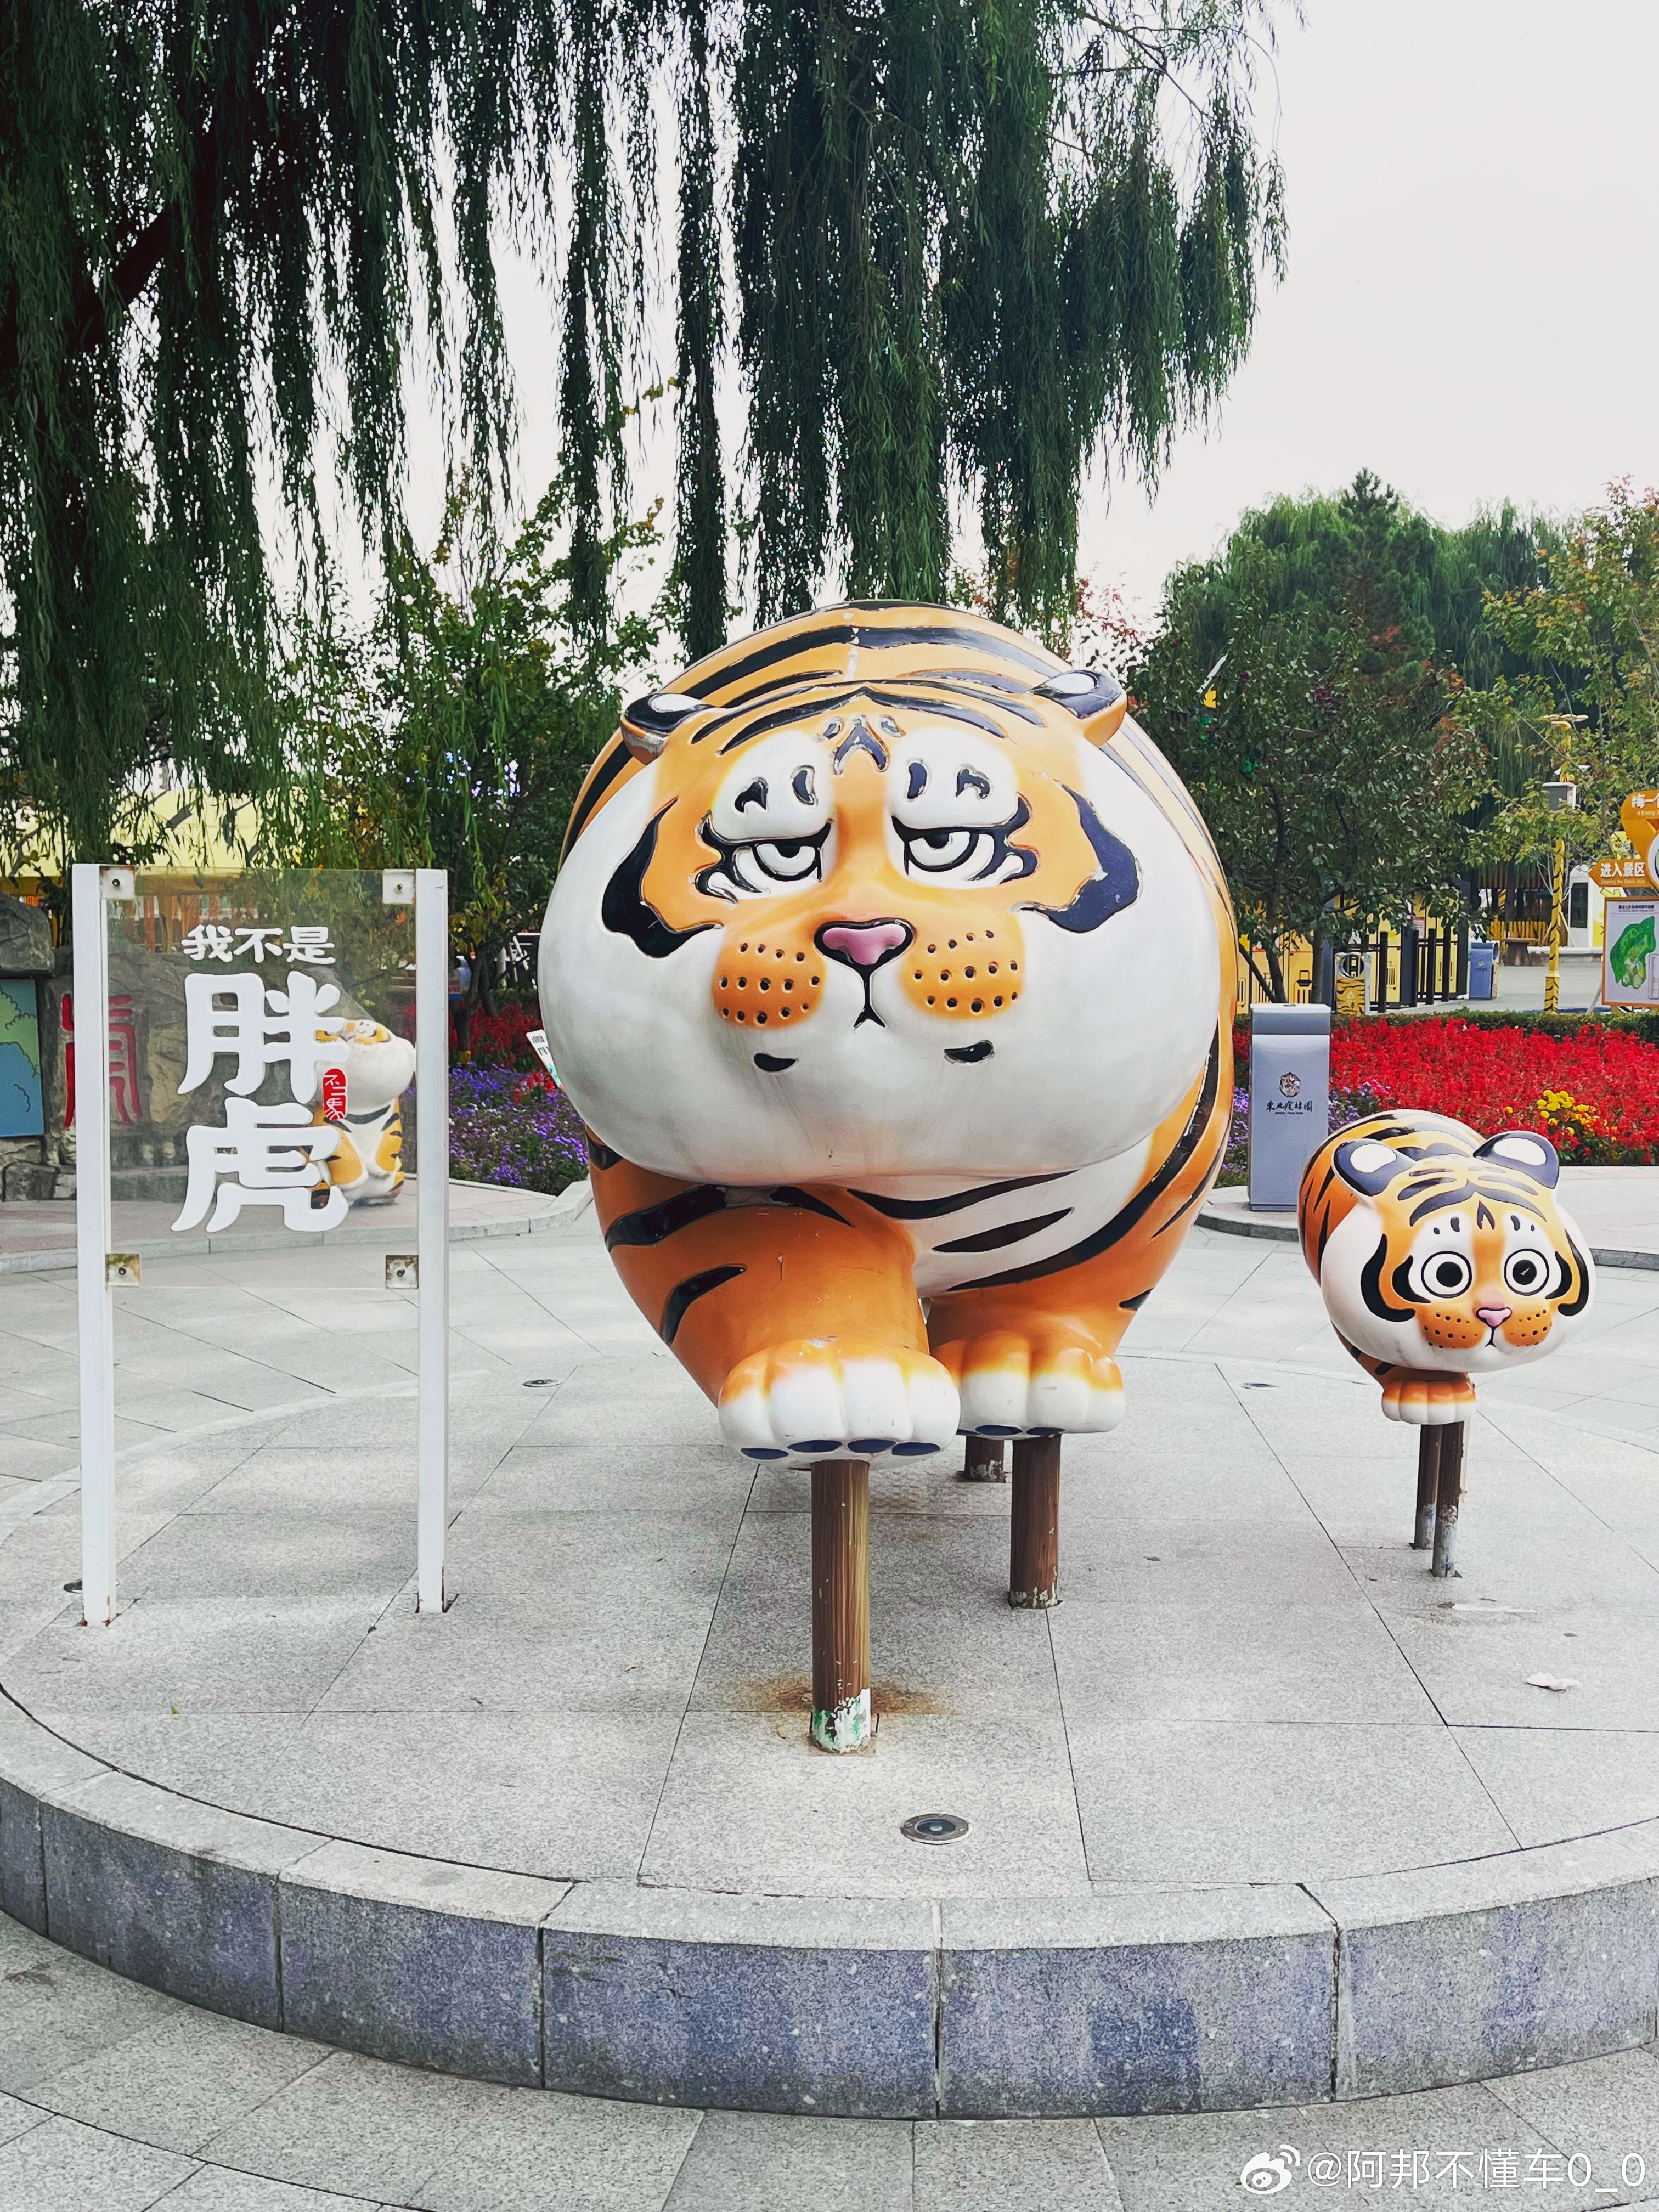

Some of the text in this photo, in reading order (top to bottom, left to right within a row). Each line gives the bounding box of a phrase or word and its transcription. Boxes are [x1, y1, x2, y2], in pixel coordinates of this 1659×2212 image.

[1600, 862, 1645, 878] 进入景区
[181, 924, 335, 964] 我不是
[171, 970, 350, 1233] 胖虎
